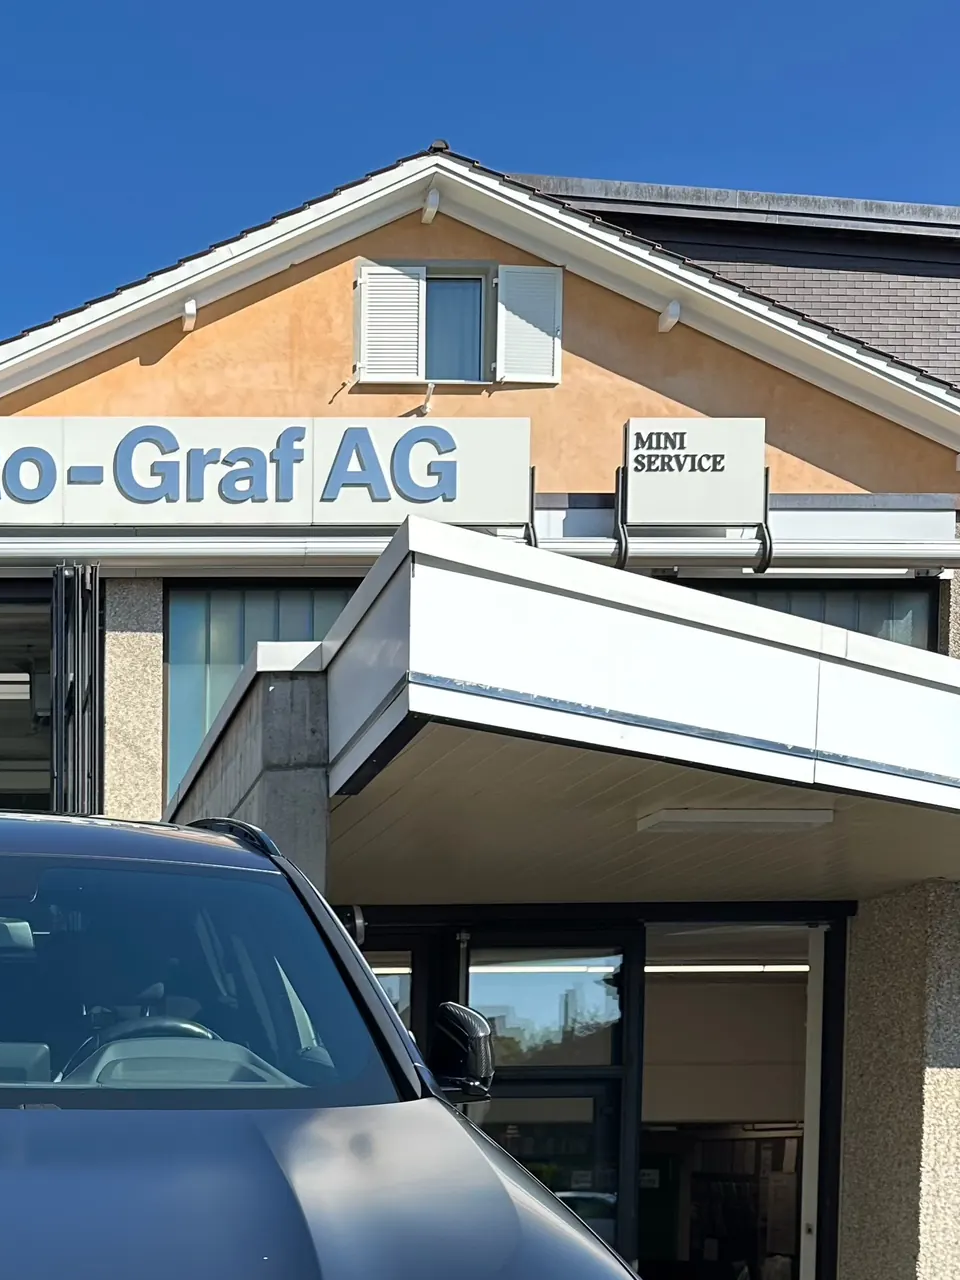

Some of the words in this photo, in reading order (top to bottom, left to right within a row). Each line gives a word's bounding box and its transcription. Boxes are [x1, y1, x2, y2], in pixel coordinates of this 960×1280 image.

[633, 432, 687, 450] MINI
[319, 425, 457, 504] AG
[633, 454, 725, 472] SERVICE
